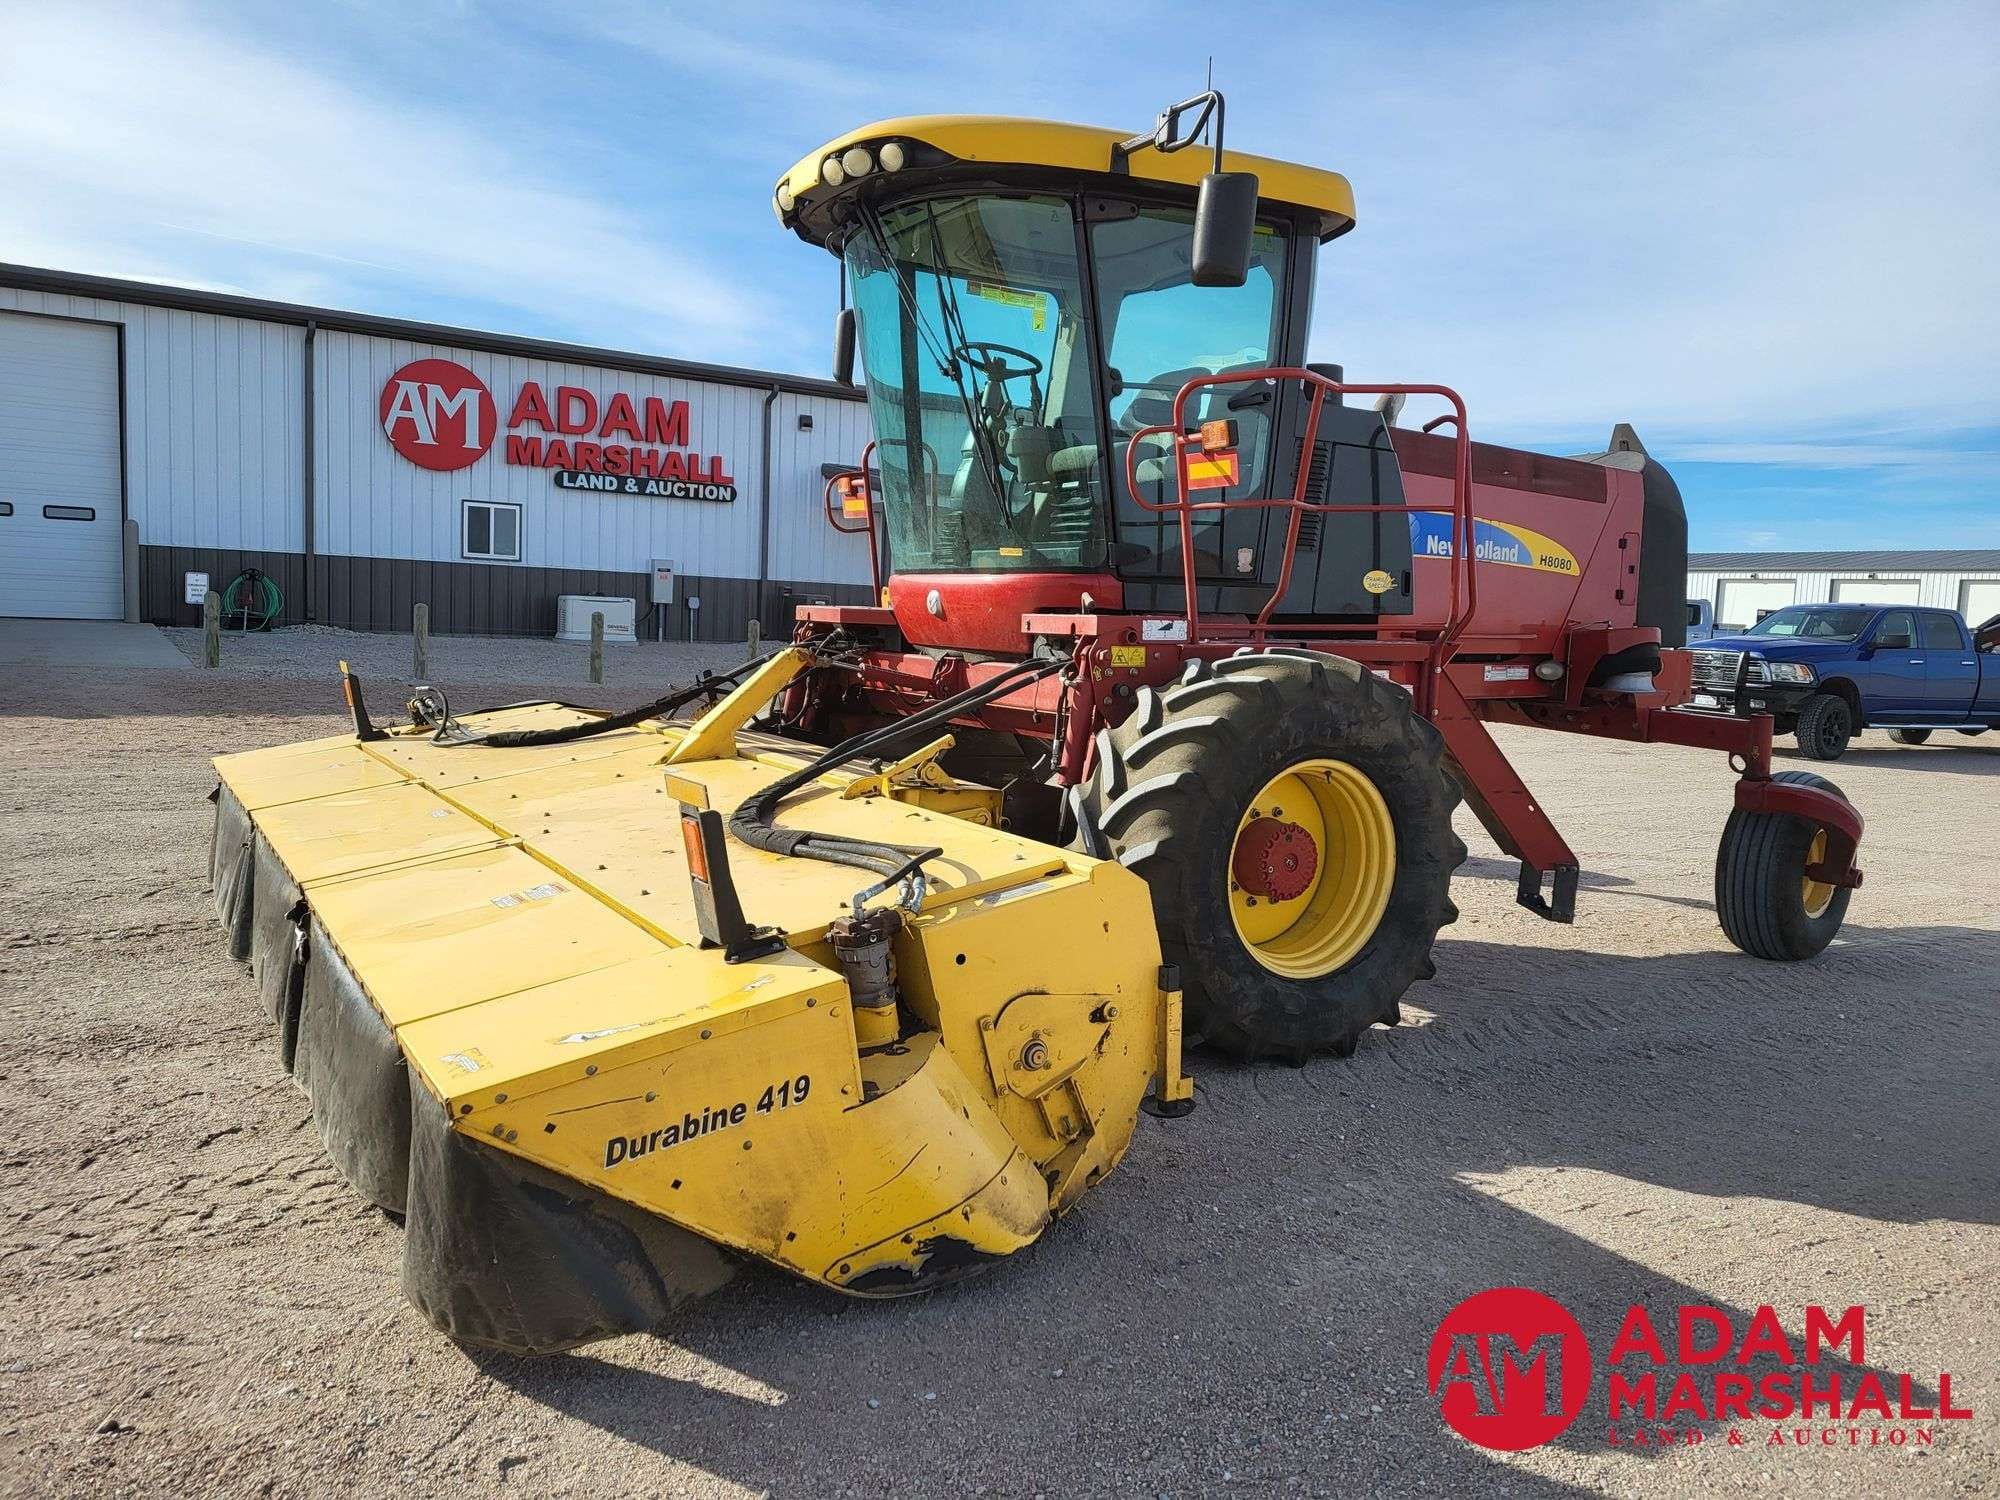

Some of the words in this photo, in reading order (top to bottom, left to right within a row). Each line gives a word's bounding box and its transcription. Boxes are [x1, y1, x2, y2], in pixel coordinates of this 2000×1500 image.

[383, 379, 483, 450] AM
[507, 381, 689, 447] ADAM
[506, 434, 734, 485] MARSHALL
[562, 472, 618, 491] LAND
[624, 478, 640, 493] &
[645, 481, 732, 501] AUCTION
[1539, 554, 1572, 571] H8080
[604, 1102, 747, 1168] Durabine
[756, 1074, 811, 1115] 419
